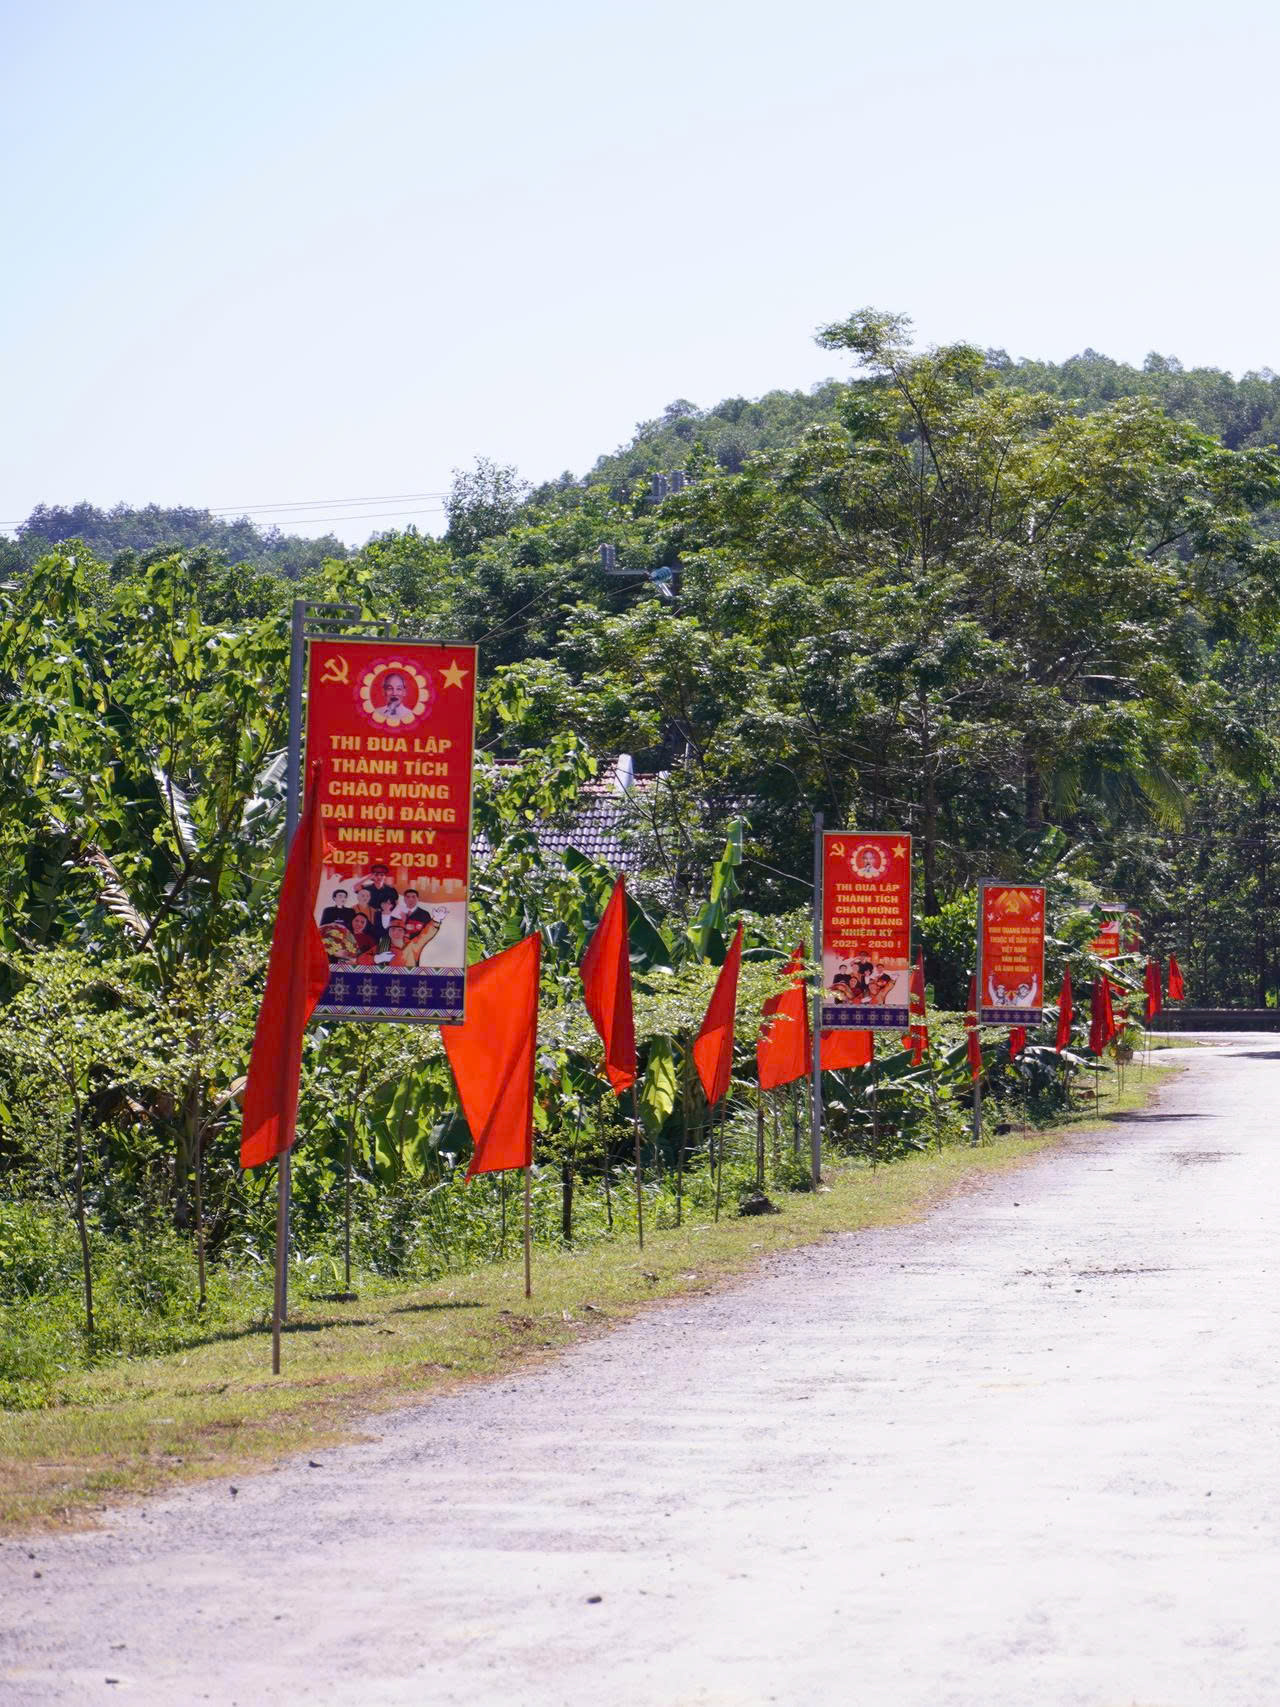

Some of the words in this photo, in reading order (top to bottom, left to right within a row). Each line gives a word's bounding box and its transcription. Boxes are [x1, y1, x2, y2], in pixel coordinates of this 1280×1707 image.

[329, 736, 360, 750] THI
[367, 736, 407, 752] ĐUA
[414, 736, 452, 756] LẬP
[331, 756, 397, 774] THÀNH
[403, 759, 448, 776] TÍCH
[328, 779, 383, 796] CHÀO
[389, 780, 449, 799] MỪNG
[320, 804, 354, 822] ĐẠI
[360, 802, 394, 823] HỘI
[400, 802, 456, 823] ĐẢNG
[338, 826, 404, 846] NHIỆM
[390, 852, 438, 867] 2030
[445, 854, 451, 868] !
[855, 883, 877, 891] ĐUA
[880, 883, 900, 893] LẬP
[836, 894, 871, 902] THÀNH
[874, 894, 899, 903] TÍCH
[835, 905, 864, 913] CHÀO
[832, 917, 849, 926] ĐẠI
[853, 916, 870, 926] HỘI
[873, 915, 903, 925] ĐẢNG
[841, 928, 876, 938] NHIỆM
[868, 940, 894, 948] 2030
